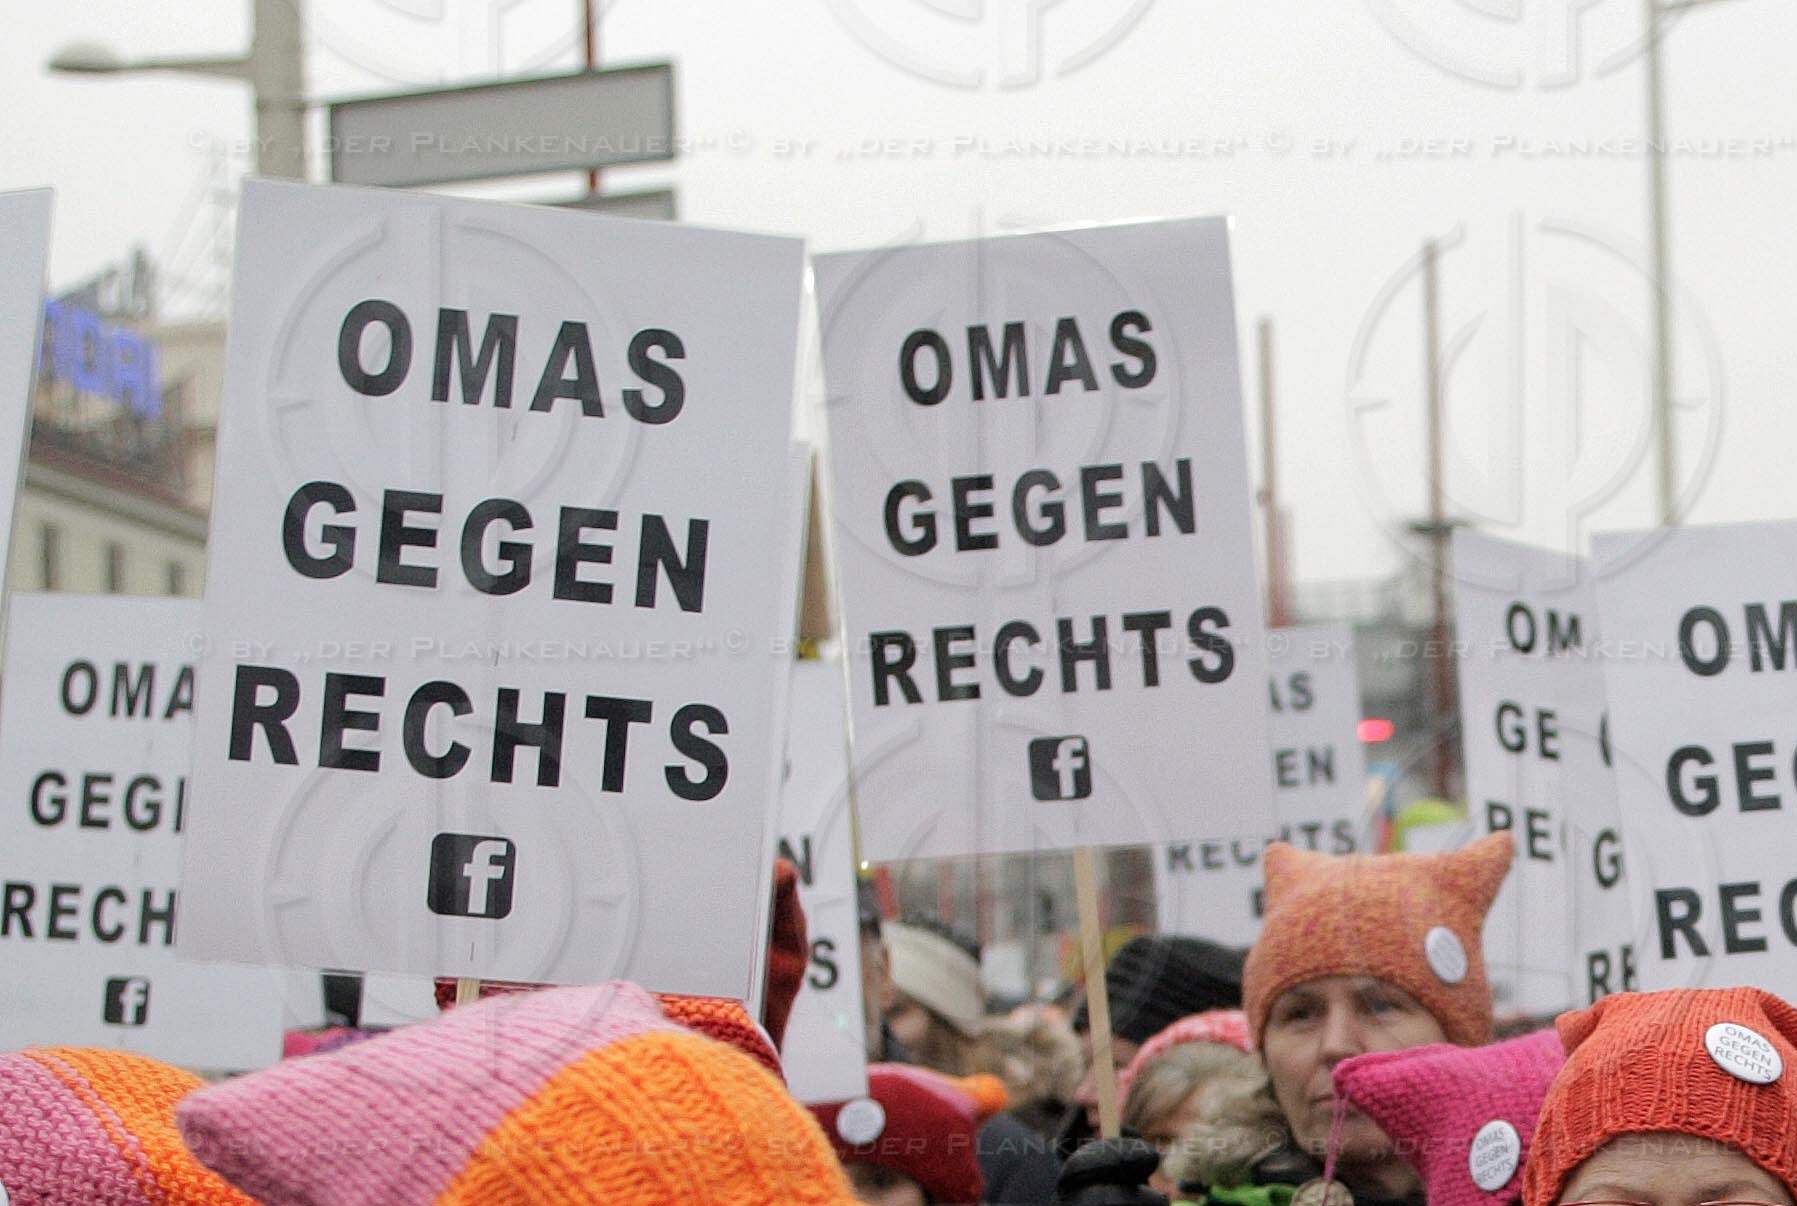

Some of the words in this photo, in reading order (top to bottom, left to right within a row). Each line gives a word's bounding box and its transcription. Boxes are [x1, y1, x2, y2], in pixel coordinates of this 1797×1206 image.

[339, 300, 685, 424] OMAS
[900, 311, 1156, 406] OMAS
[884, 459, 1195, 556] GEGEN
[283, 481, 708, 613] GEGEN
[870, 607, 1234, 706] RECHTS
[1506, 602, 1583, 653] OM
[61, 660, 195, 720] OMA
[229, 665, 728, 801] RECHTS
[31, 770, 186, 833] GEG
[1, 880, 177, 946] RECH
[1714, 1046, 1772, 1081] RECHTS
[1719, 1035, 1772, 1067] GEGEN
[1725, 1026, 1770, 1053] OMAS
